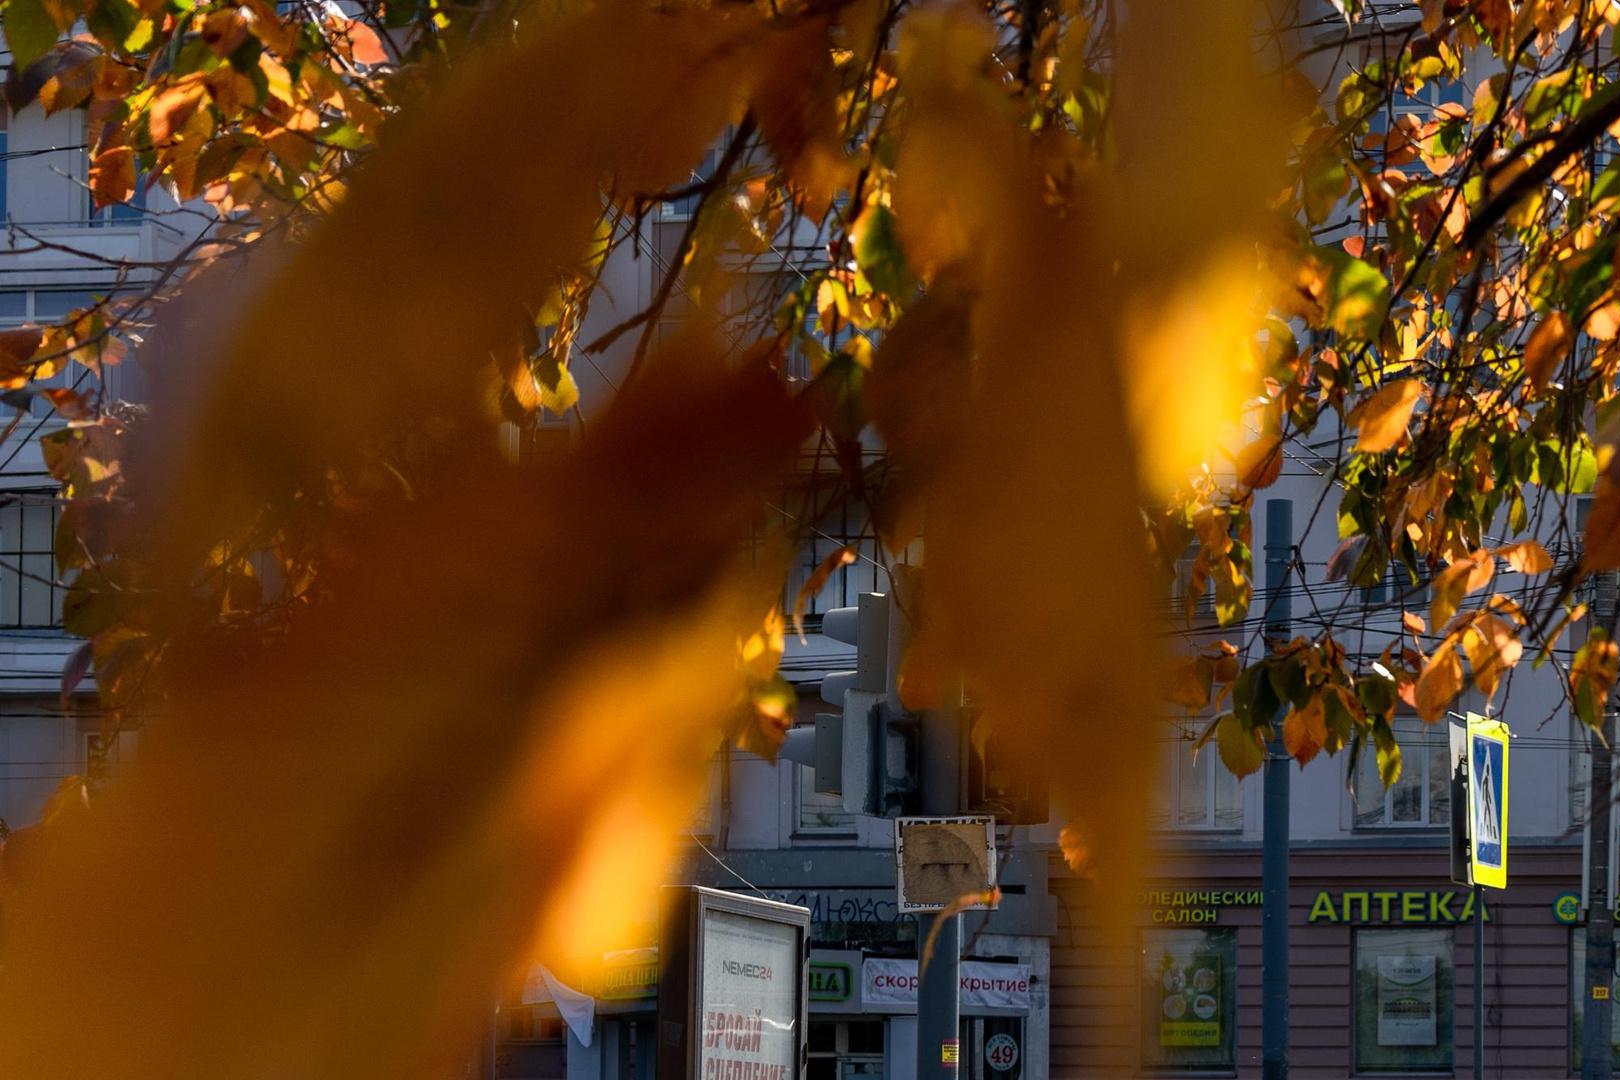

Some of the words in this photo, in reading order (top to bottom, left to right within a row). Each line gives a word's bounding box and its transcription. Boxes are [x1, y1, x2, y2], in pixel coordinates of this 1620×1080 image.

[1152, 909, 1217, 923] САЛОН
[1308, 890, 1491, 923] АПТЕКА
[722, 960, 772, 981] NEMEC24
[875, 974, 919, 992] скор
[705, 1009, 762, 1052] БРОСАЙ
[992, 1046, 1013, 1064] 49
